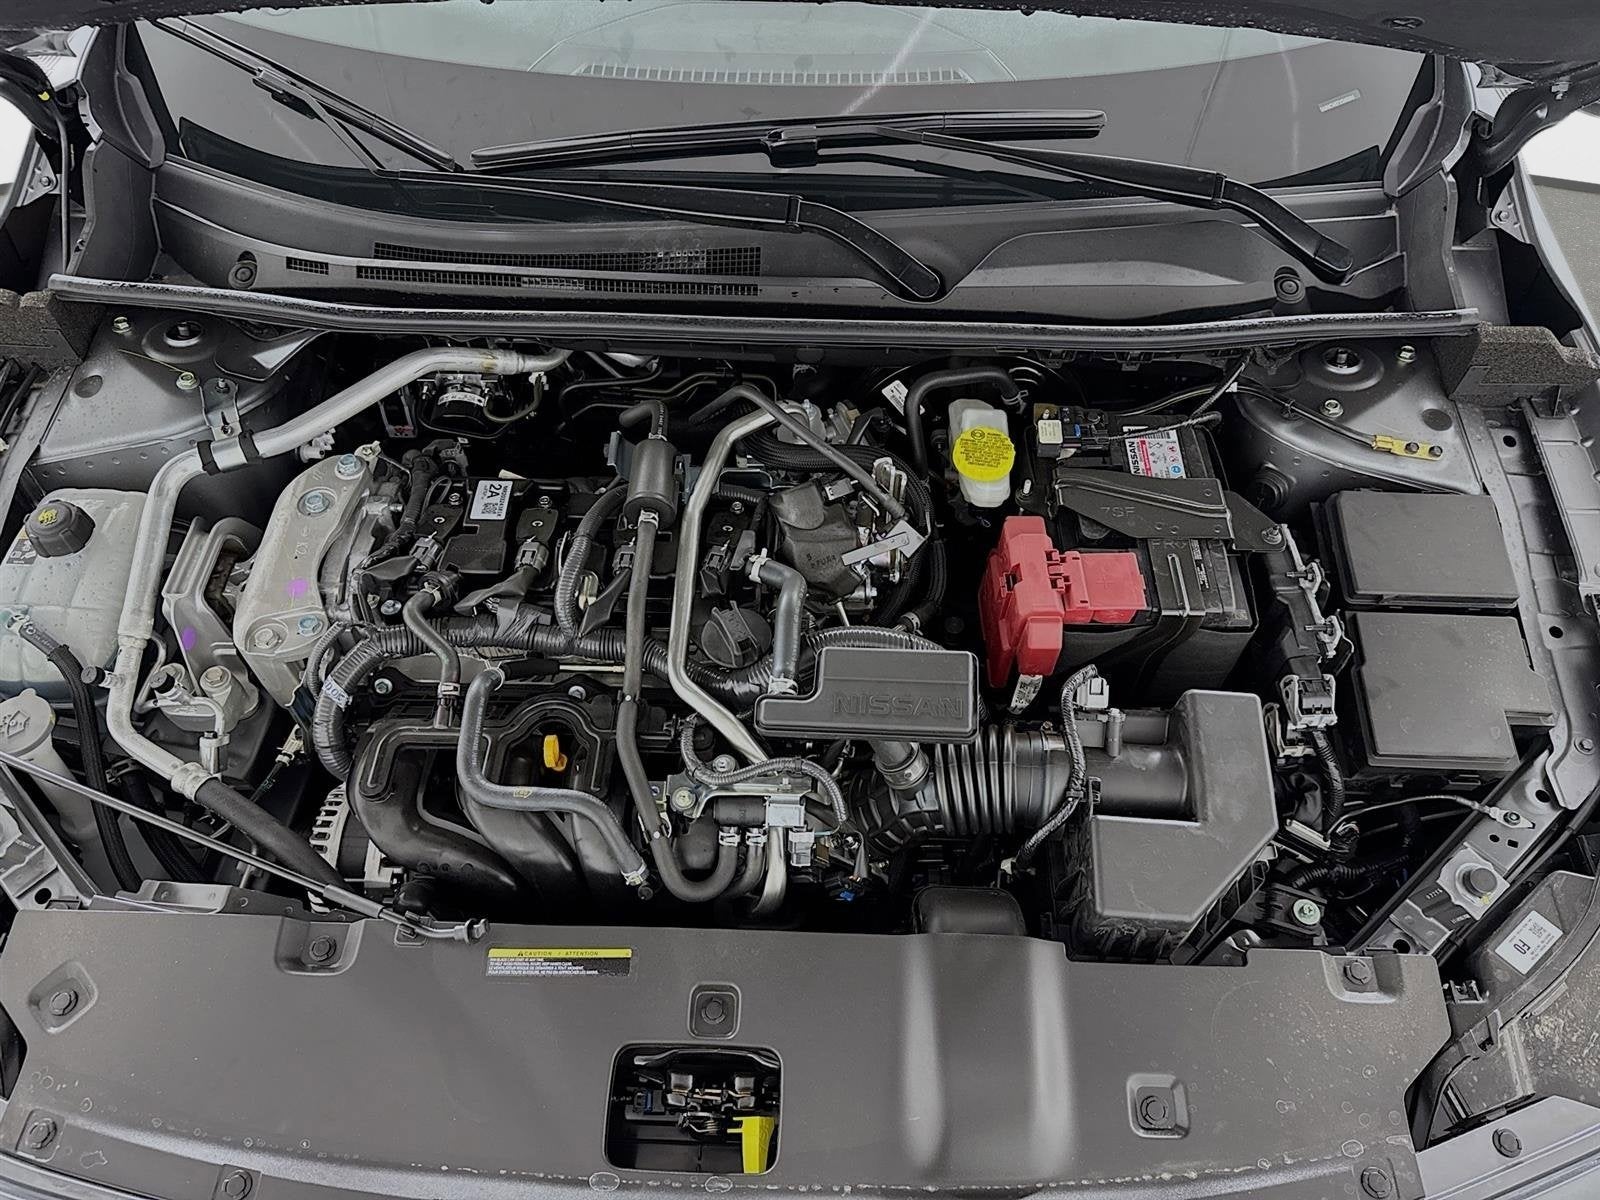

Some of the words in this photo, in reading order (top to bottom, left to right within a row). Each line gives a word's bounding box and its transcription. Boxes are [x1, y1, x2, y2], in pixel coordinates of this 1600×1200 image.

[1127, 441, 1141, 474] NISSAN
[487, 483, 502, 499] 2A
[833, 693, 964, 720] NISSAN
